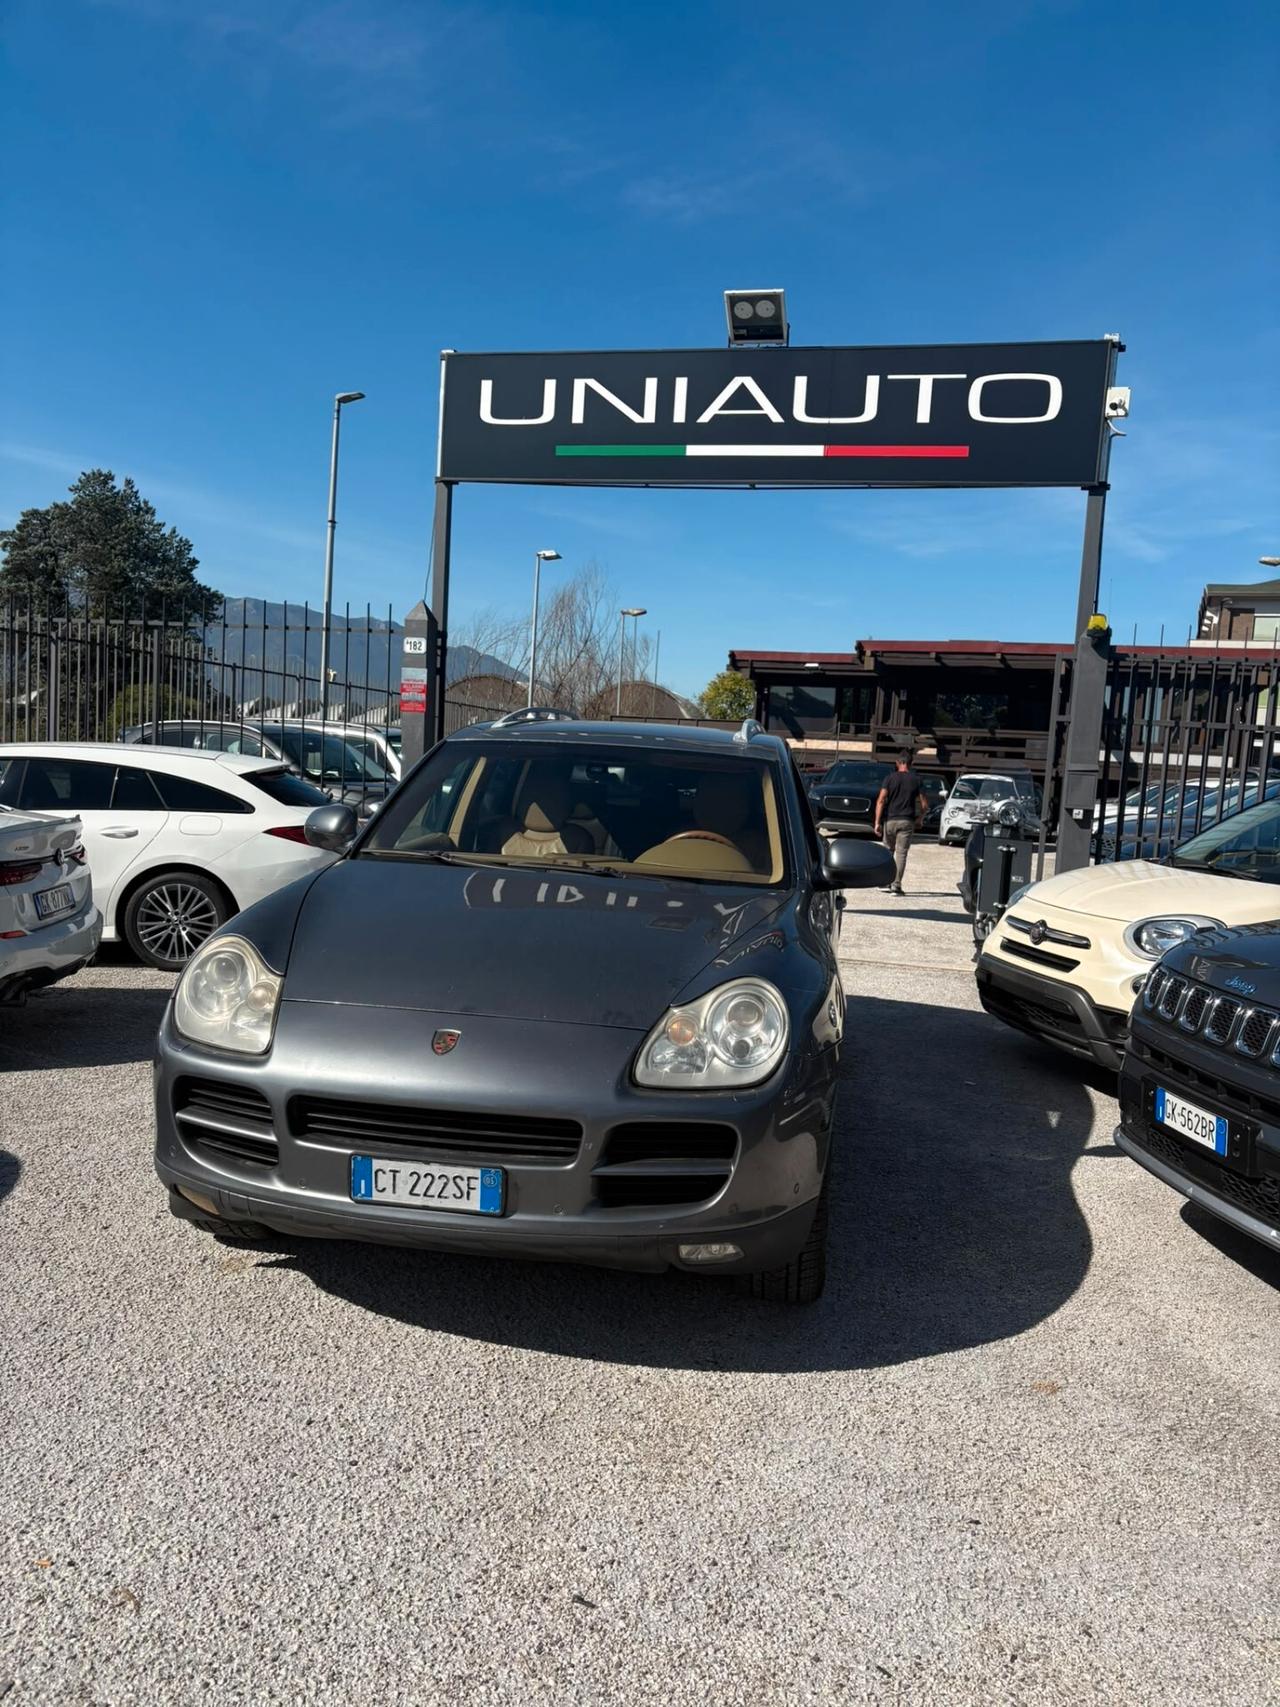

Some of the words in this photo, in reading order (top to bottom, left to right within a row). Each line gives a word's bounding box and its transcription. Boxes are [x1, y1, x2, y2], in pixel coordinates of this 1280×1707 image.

[479, 373, 1063, 426] UNIAUTO
[409, 641, 423, 651] 182
[1225, 976, 1257, 995] Jeep
[1165, 1098, 1177, 1123] GK
[1180, 1106, 1216, 1143] 562BR
[374, 1168, 401, 1195] CT
[408, 1171, 479, 1201] 222SF
